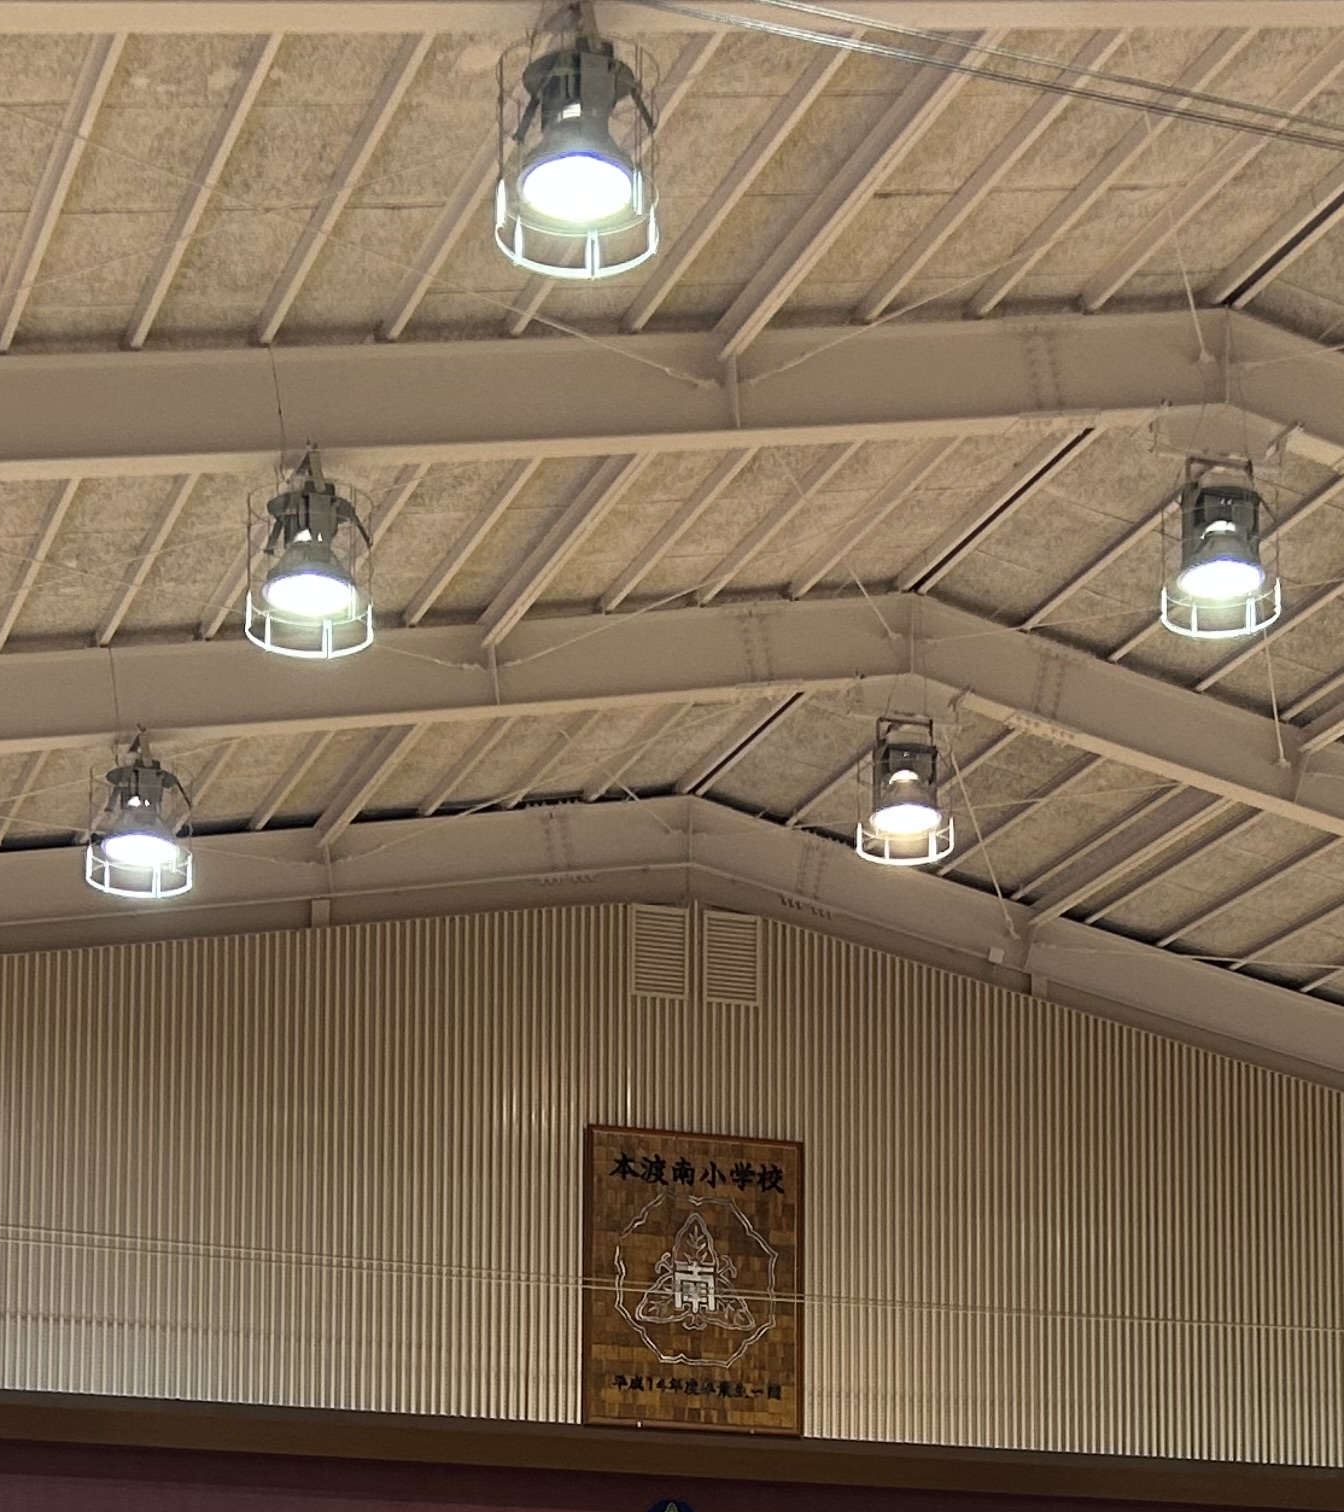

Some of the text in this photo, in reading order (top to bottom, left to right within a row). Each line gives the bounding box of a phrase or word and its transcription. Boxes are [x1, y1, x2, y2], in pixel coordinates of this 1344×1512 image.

[608, 1153, 785, 1194] 本渡南小学校
